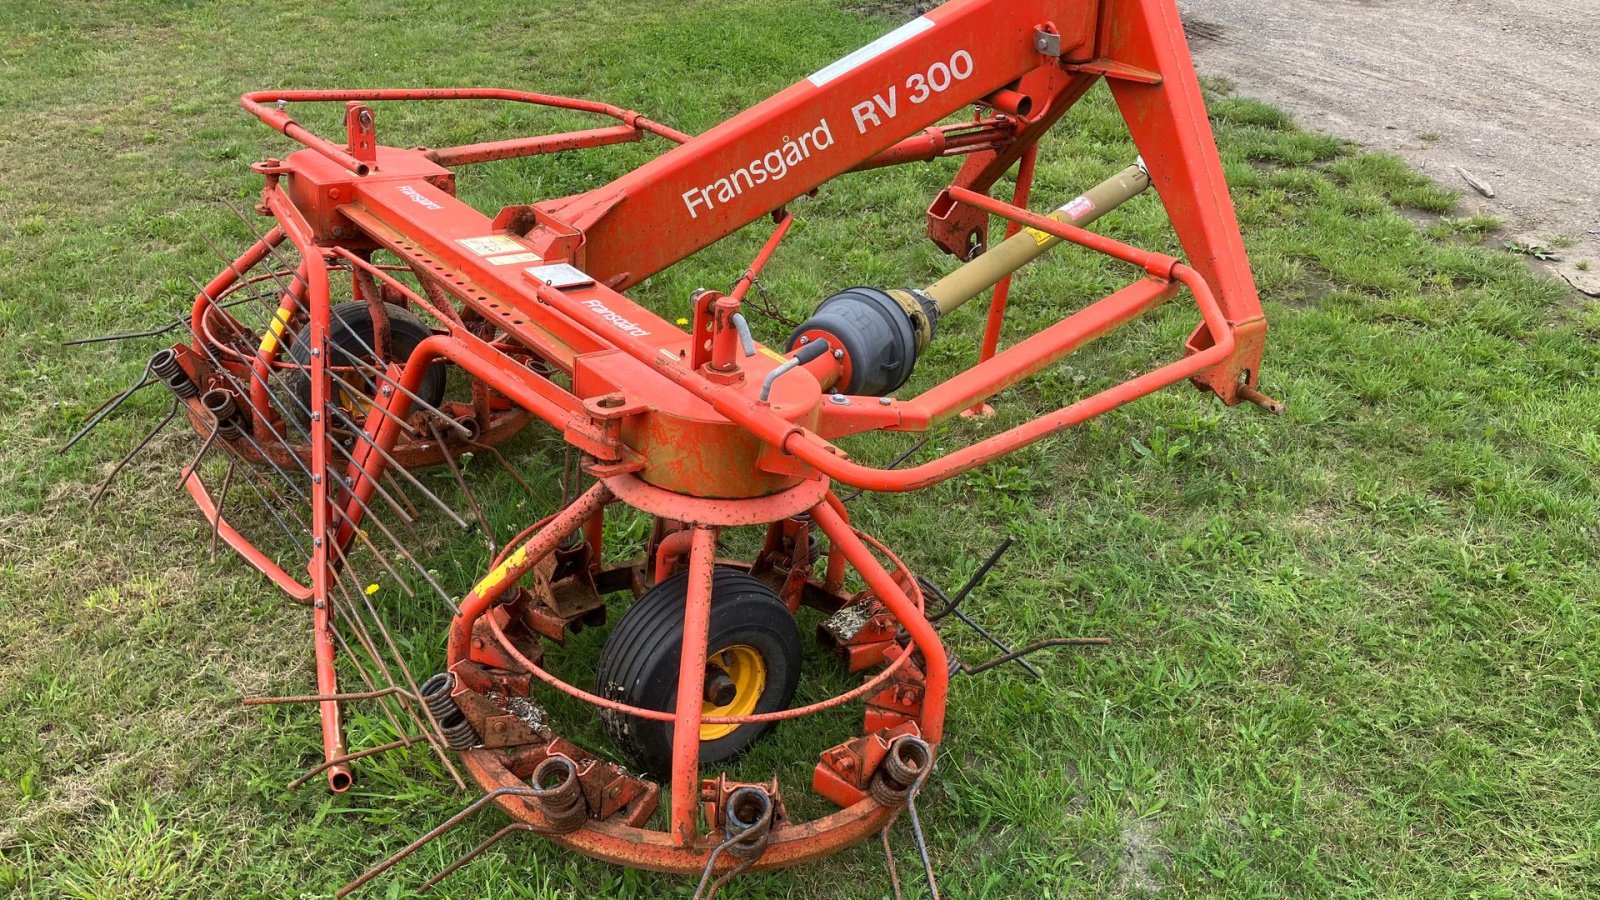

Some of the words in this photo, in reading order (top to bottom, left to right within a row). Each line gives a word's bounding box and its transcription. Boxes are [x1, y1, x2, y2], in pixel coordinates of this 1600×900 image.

[681, 118, 834, 219] Fransgård
[851, 86, 897, 135] RV
[905, 50, 974, 104] 300
[581, 299, 652, 337] Fransgård
